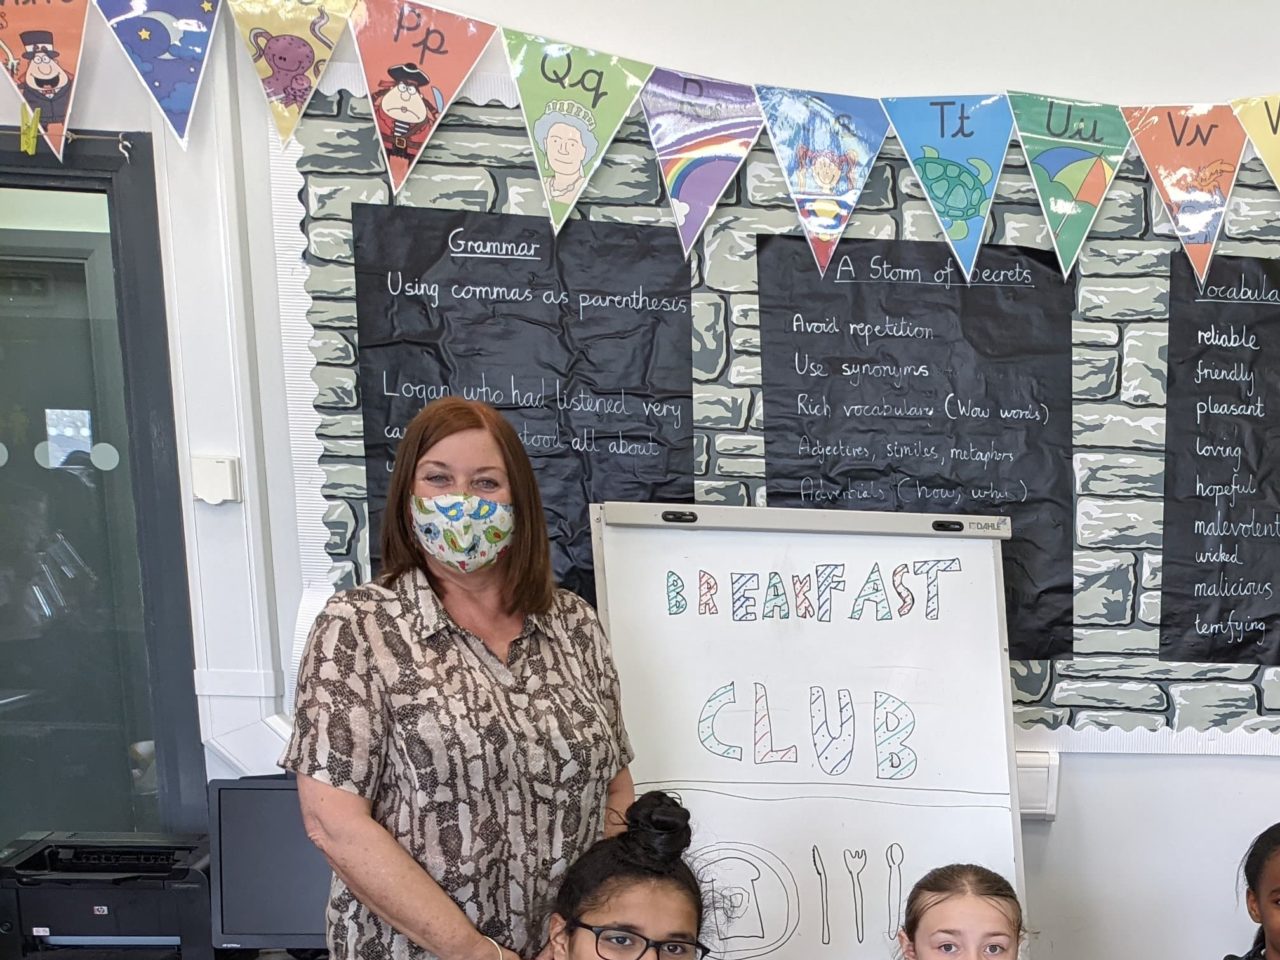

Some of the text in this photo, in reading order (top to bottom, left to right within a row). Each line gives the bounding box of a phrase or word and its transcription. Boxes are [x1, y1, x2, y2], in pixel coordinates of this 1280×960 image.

[540, 51, 608, 109] Qq
[929, 101, 974, 139] Tt
[1046, 103, 1104, 144] Uu
[449, 228, 540, 256] Grammar
[837, 255, 855, 280] A
[870, 255, 922, 282] Storm
[934, 258, 954, 289] of
[387, 271, 688, 320] Using commas as parenthesis
[792, 313, 934, 346] Avoid repetition
[1197, 325, 1261, 350] reliable
[795, 352, 929, 387] Use synonyms
[1194, 360, 1255, 396] friendly
[463, 372, 504, 404] who
[511, 374, 549, 410] had
[556, 379, 633, 416] listened
[643, 401, 682, 430] very
[797, 393, 831, 418] Rich
[1196, 397, 1265, 424] pleasant
[571, 428, 596, 452] all
[608, 431, 660, 456] about
[1196, 435, 1241, 472] loving
[1196, 473, 1257, 508] hopeful
[1195, 543, 1244, 565] wicked
[666, 557, 962, 622] BREAKFAST
[1194, 571, 1273, 600] malicious
[1194, 610, 1266, 646] terrifying
[698, 680, 918, 780] CLUB
